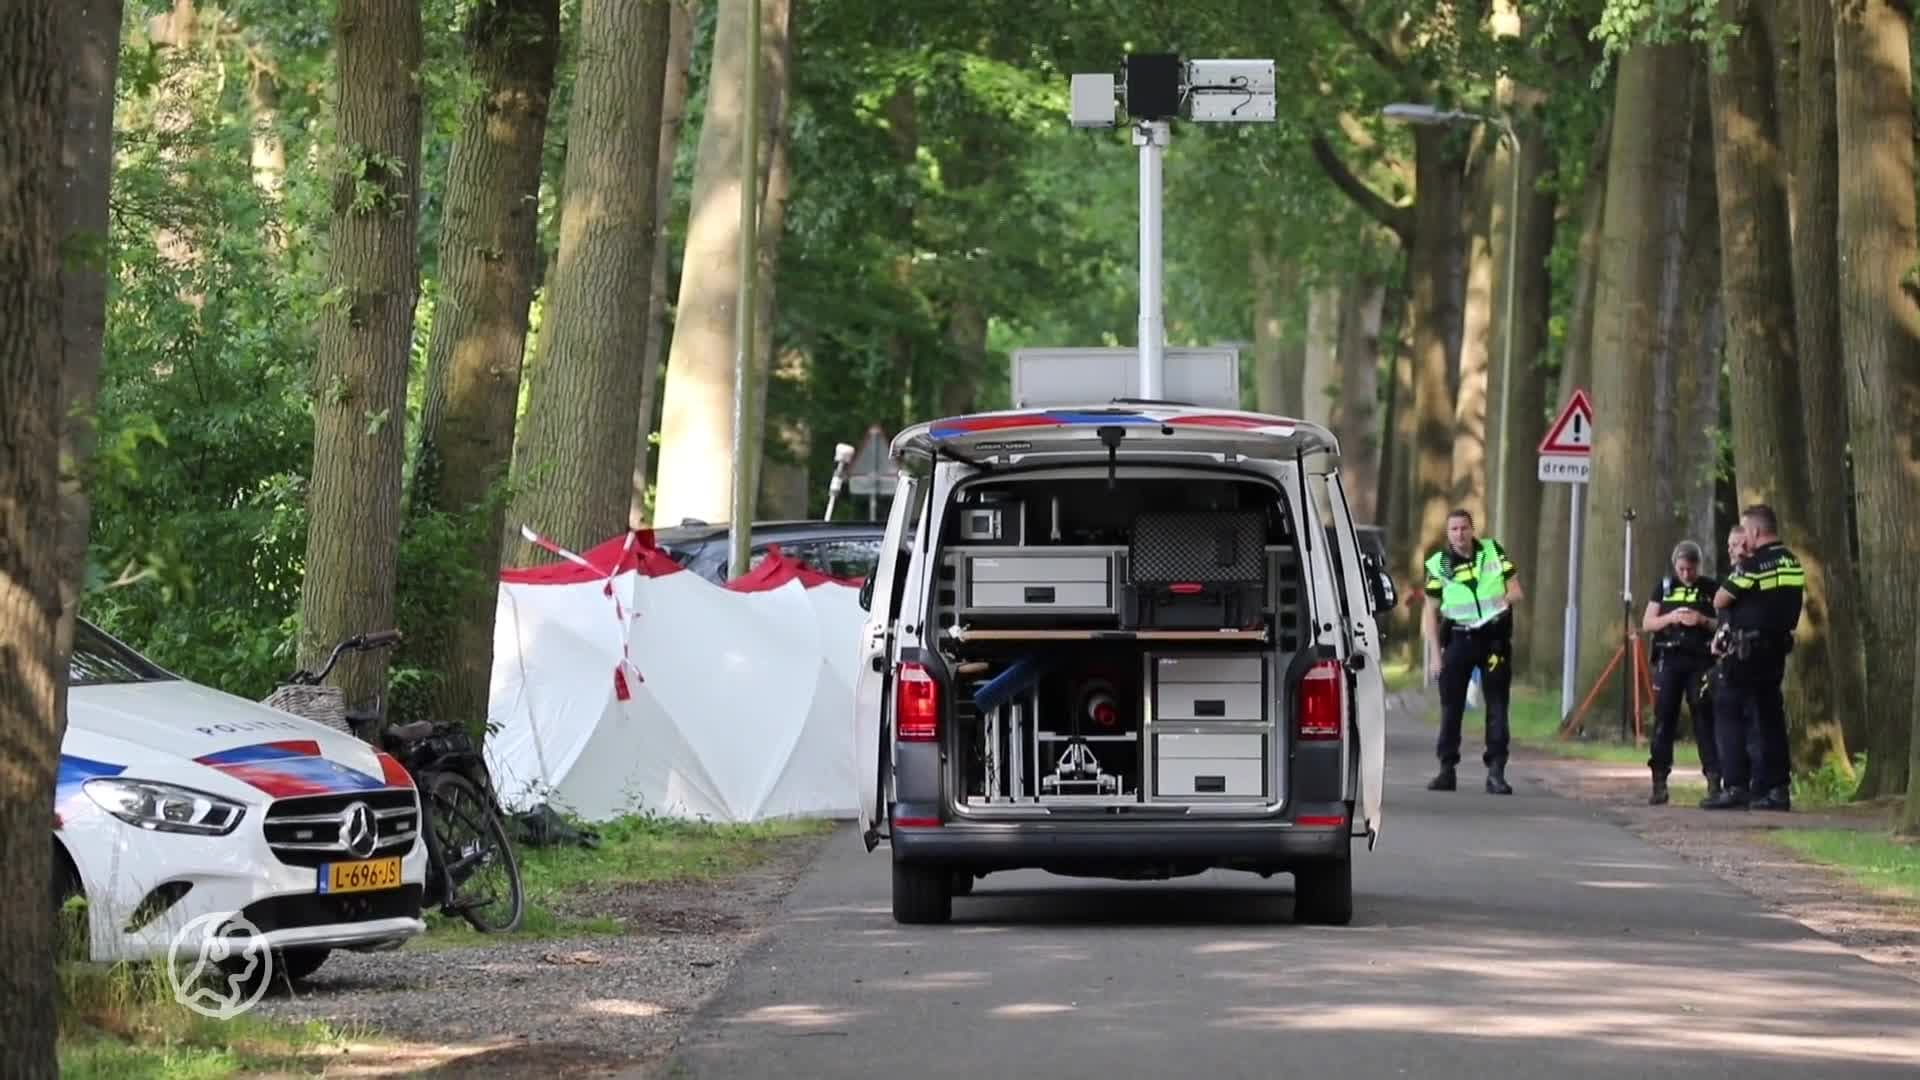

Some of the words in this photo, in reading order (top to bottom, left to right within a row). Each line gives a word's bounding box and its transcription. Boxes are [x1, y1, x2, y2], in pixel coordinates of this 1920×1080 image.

[1543, 462, 1589, 476] dremp
[195, 720, 302, 736] POLITIE
[335, 861, 396, 888] L-696-JS
